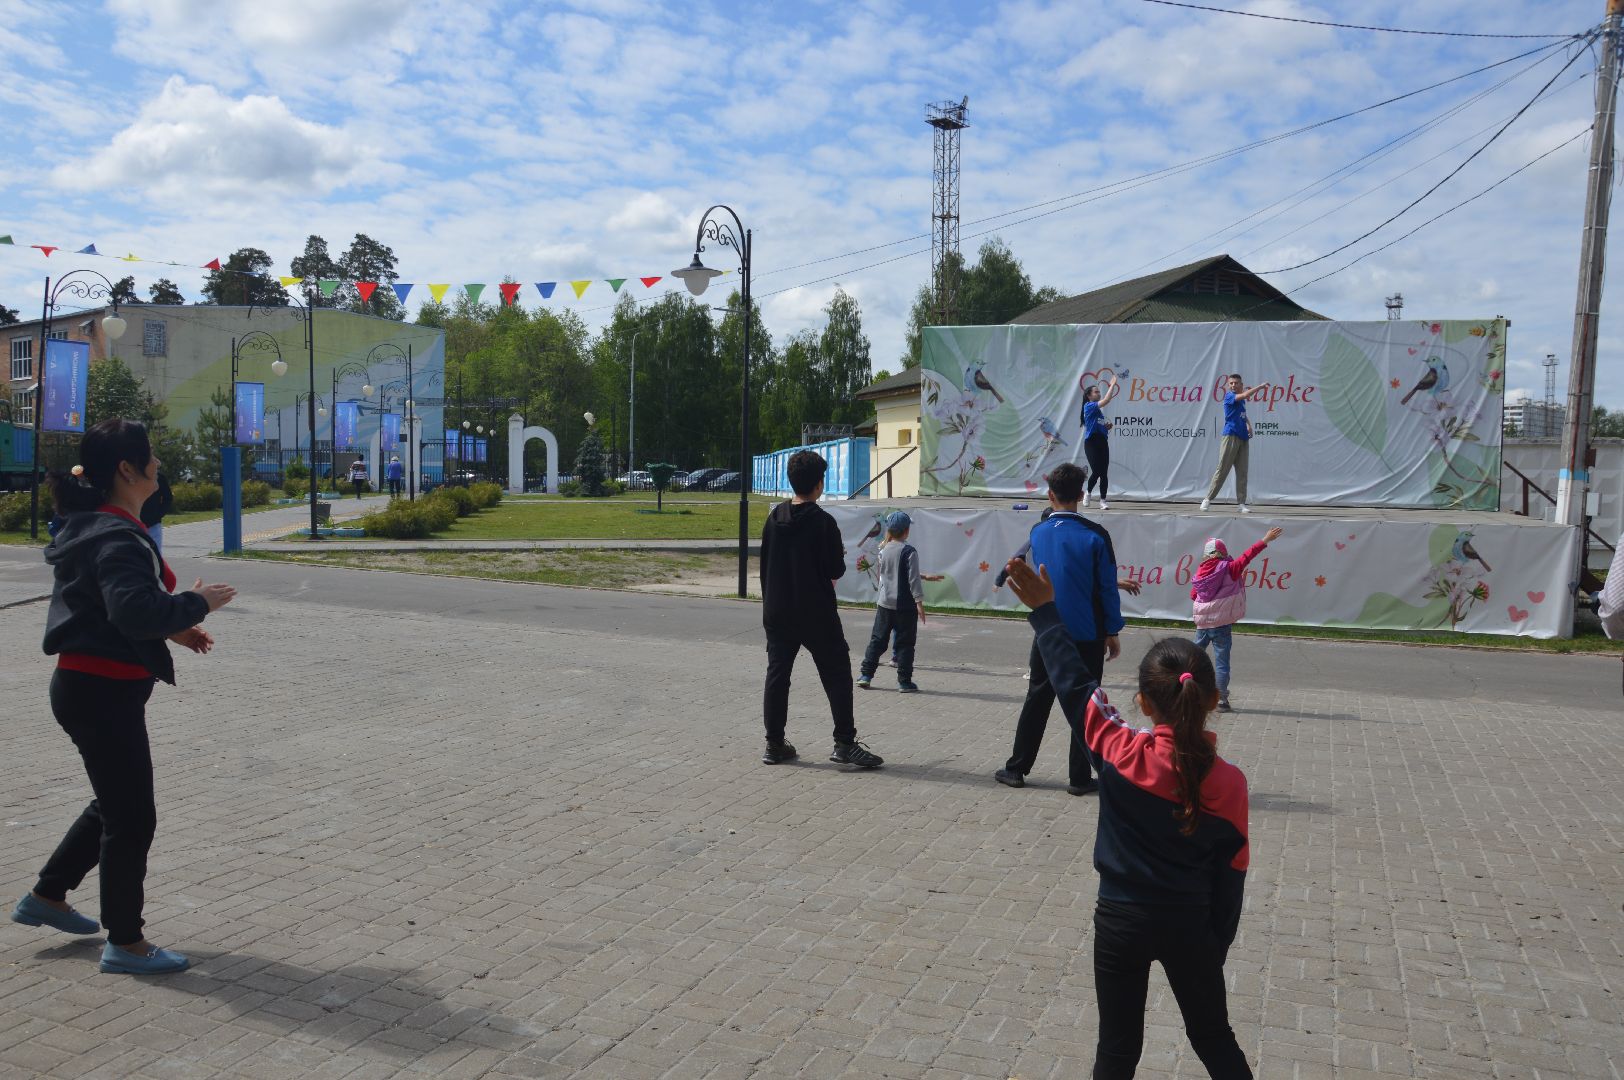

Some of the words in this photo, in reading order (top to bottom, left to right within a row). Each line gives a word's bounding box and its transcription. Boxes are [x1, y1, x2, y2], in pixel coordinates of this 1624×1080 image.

[1128, 377, 1203, 402] Весна
[1114, 416, 1153, 426] ПАРКИ
[1255, 422, 1279, 430] ПАРК
[1114, 427, 1206, 438] ПОДМОСКОВЬЯ
[1175, 554, 1194, 586] в
